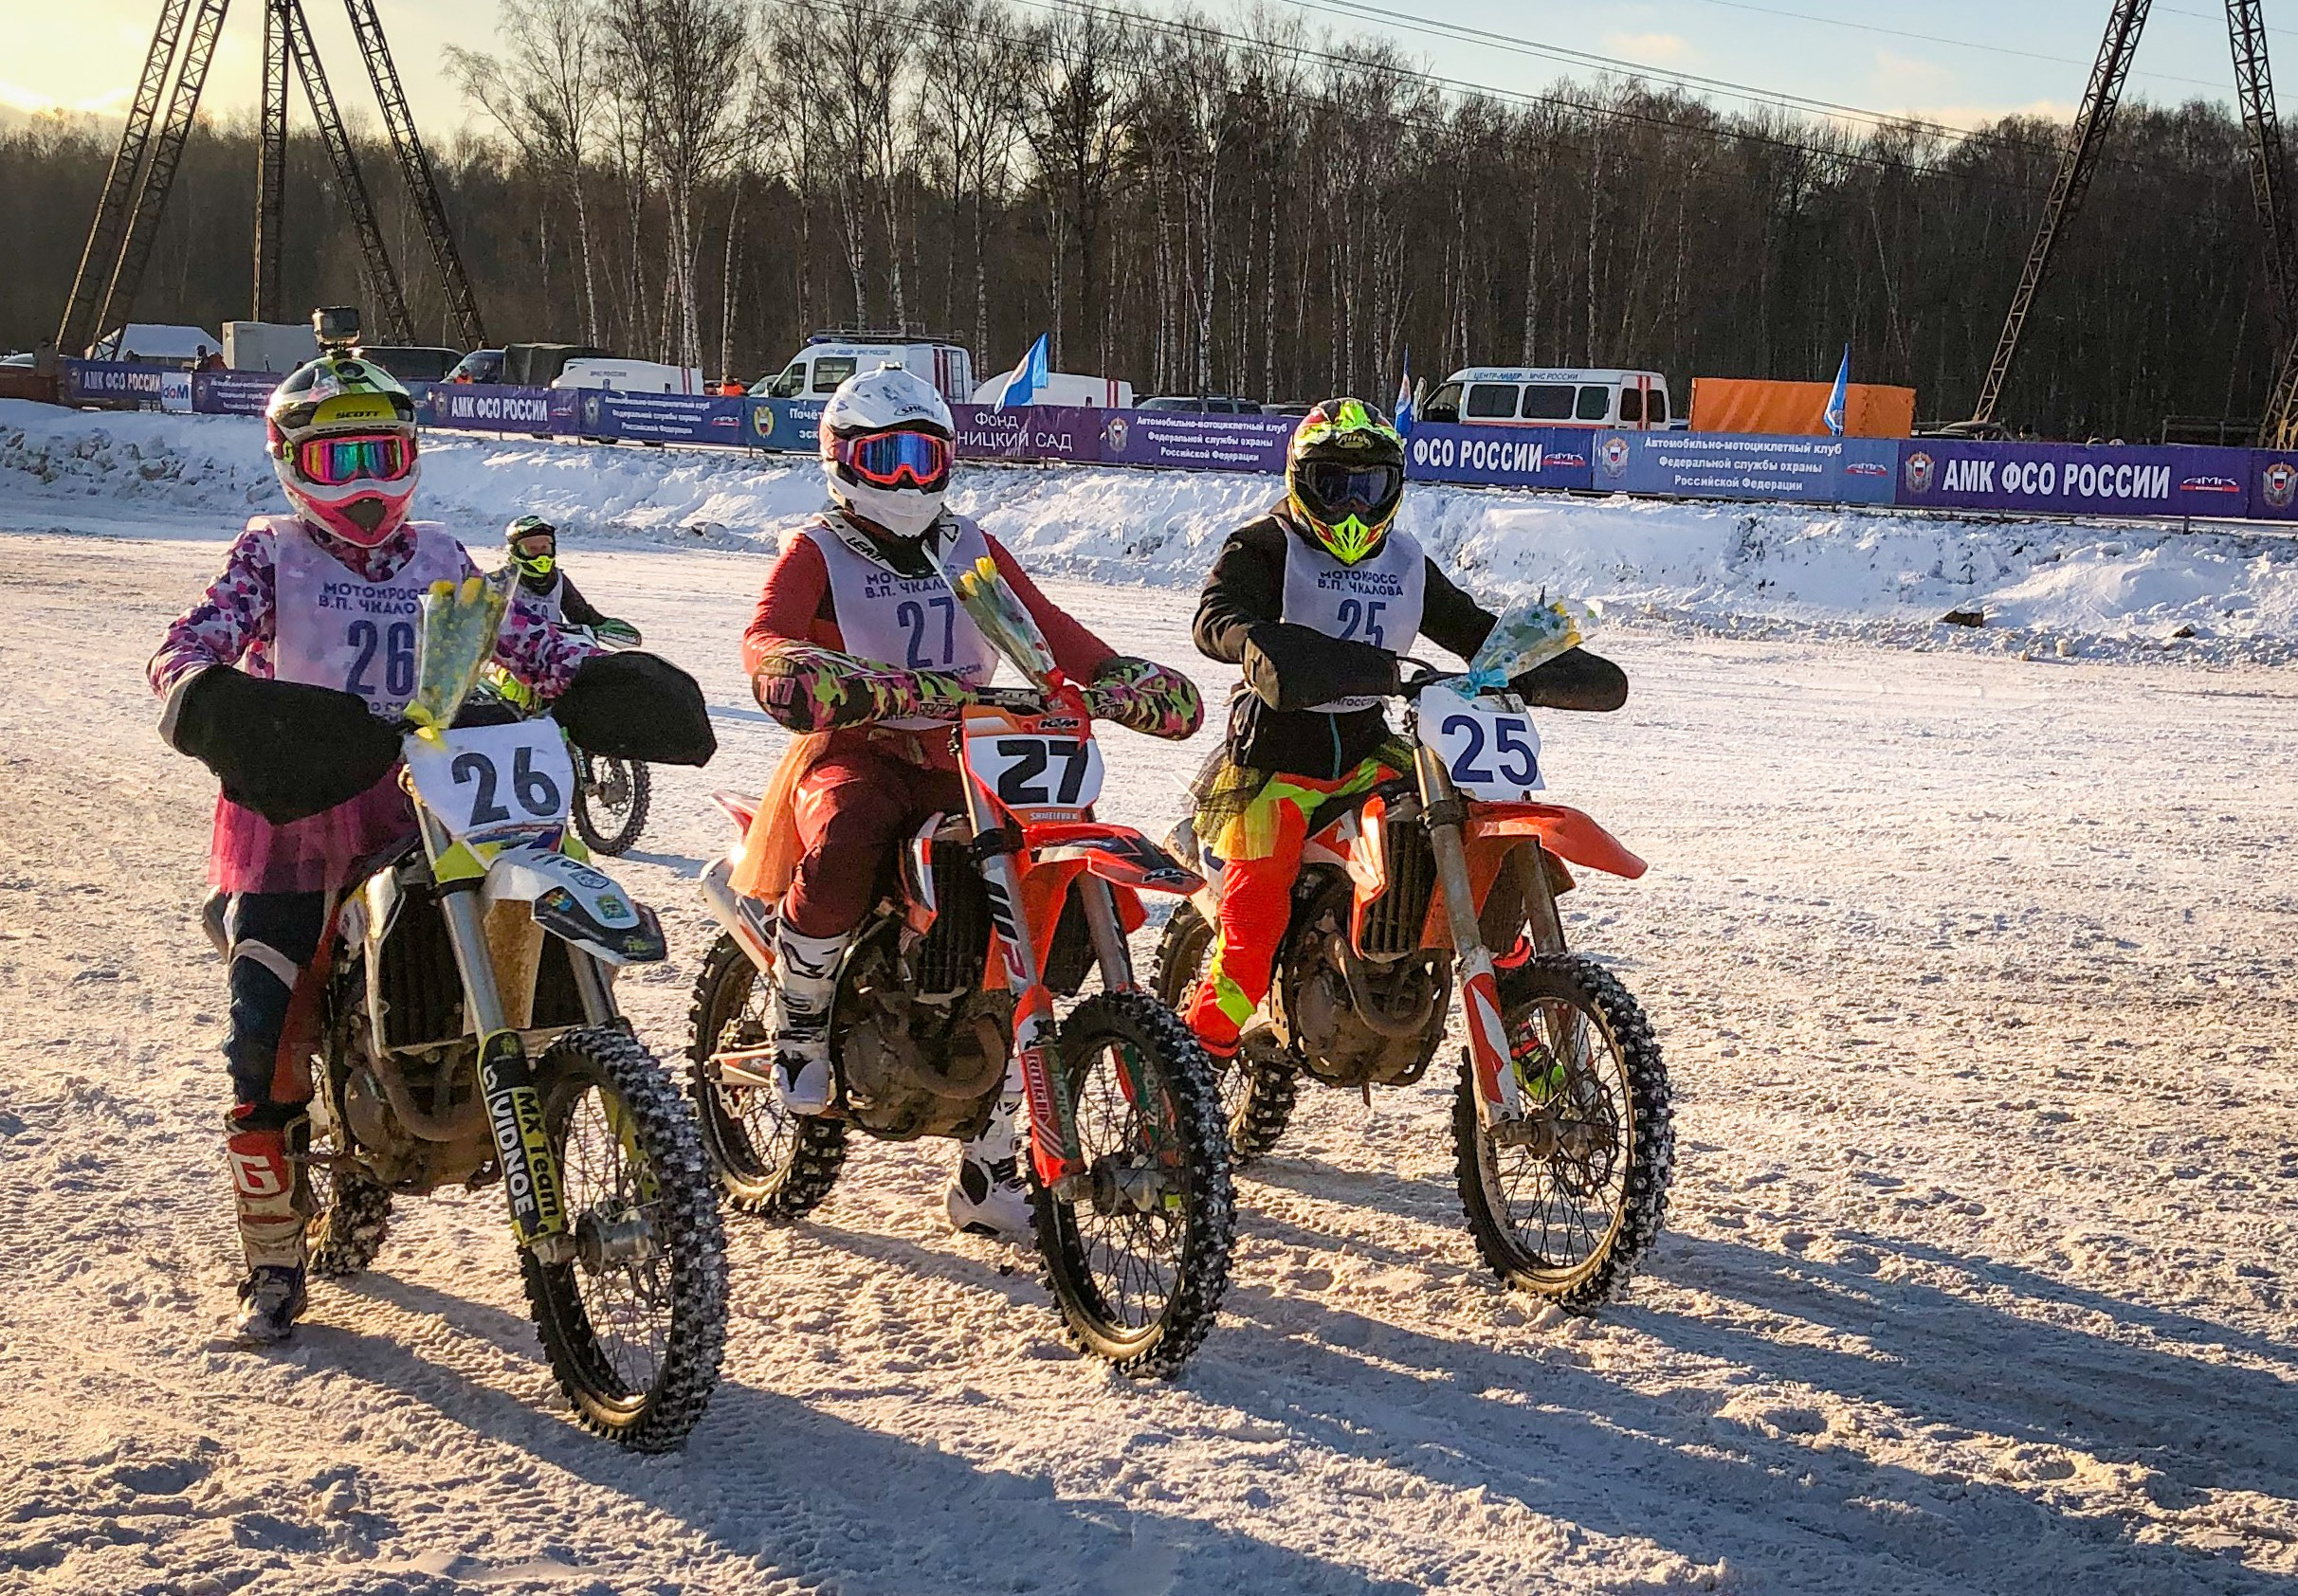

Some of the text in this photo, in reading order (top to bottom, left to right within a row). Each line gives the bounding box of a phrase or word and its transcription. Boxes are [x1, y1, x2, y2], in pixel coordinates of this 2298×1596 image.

[83, 371, 161, 392] АМК ФСО РОССИИ
[336, 410, 380, 419] SCOTT
[451, 396, 548, 422] АМК ФСО РОССИИ
[1137, 415, 1287, 435] Автомобильно-мотоциклетный клуб
[957, 429, 1072, 452] НИЦКИЙ САД
[1147, 430, 1273, 448] Федеральной службы охраны
[1645, 436, 1843, 455] Автомобильно-мотоциклетный клуб
[1160, 446, 1259, 462] Российской Федерации
[1413, 437, 1543, 472] ФСО РОССИИ
[1659, 455, 1822, 473] Федеральной службы охраны
[1674, 474, 1803, 492] Российской Федерации
[1942, 459, 2170, 499] АМК ФСО РОССИИ
[866, 585, 897, 599] В.П.
[899, 578, 949, 594] ЧКАЛО
[1318, 578, 1404, 596] В.П. ЧКАЛОВА
[1320, 571, 1397, 585] МОТОКРОСС
[318, 594, 417, 615] В.П. ЧКАЛО
[897, 596, 955, 669] 27
[1338, 598, 1387, 649] 25
[346, 619, 416, 697] 26
[1040, 716, 1080, 729] KTM
[1441, 715, 1538, 786] 25
[997, 739, 1089, 805] 27
[451, 746, 561, 827] 26
[491, 1093, 536, 1216] VIDNOE
[517, 1092, 559, 1216] MX Team
